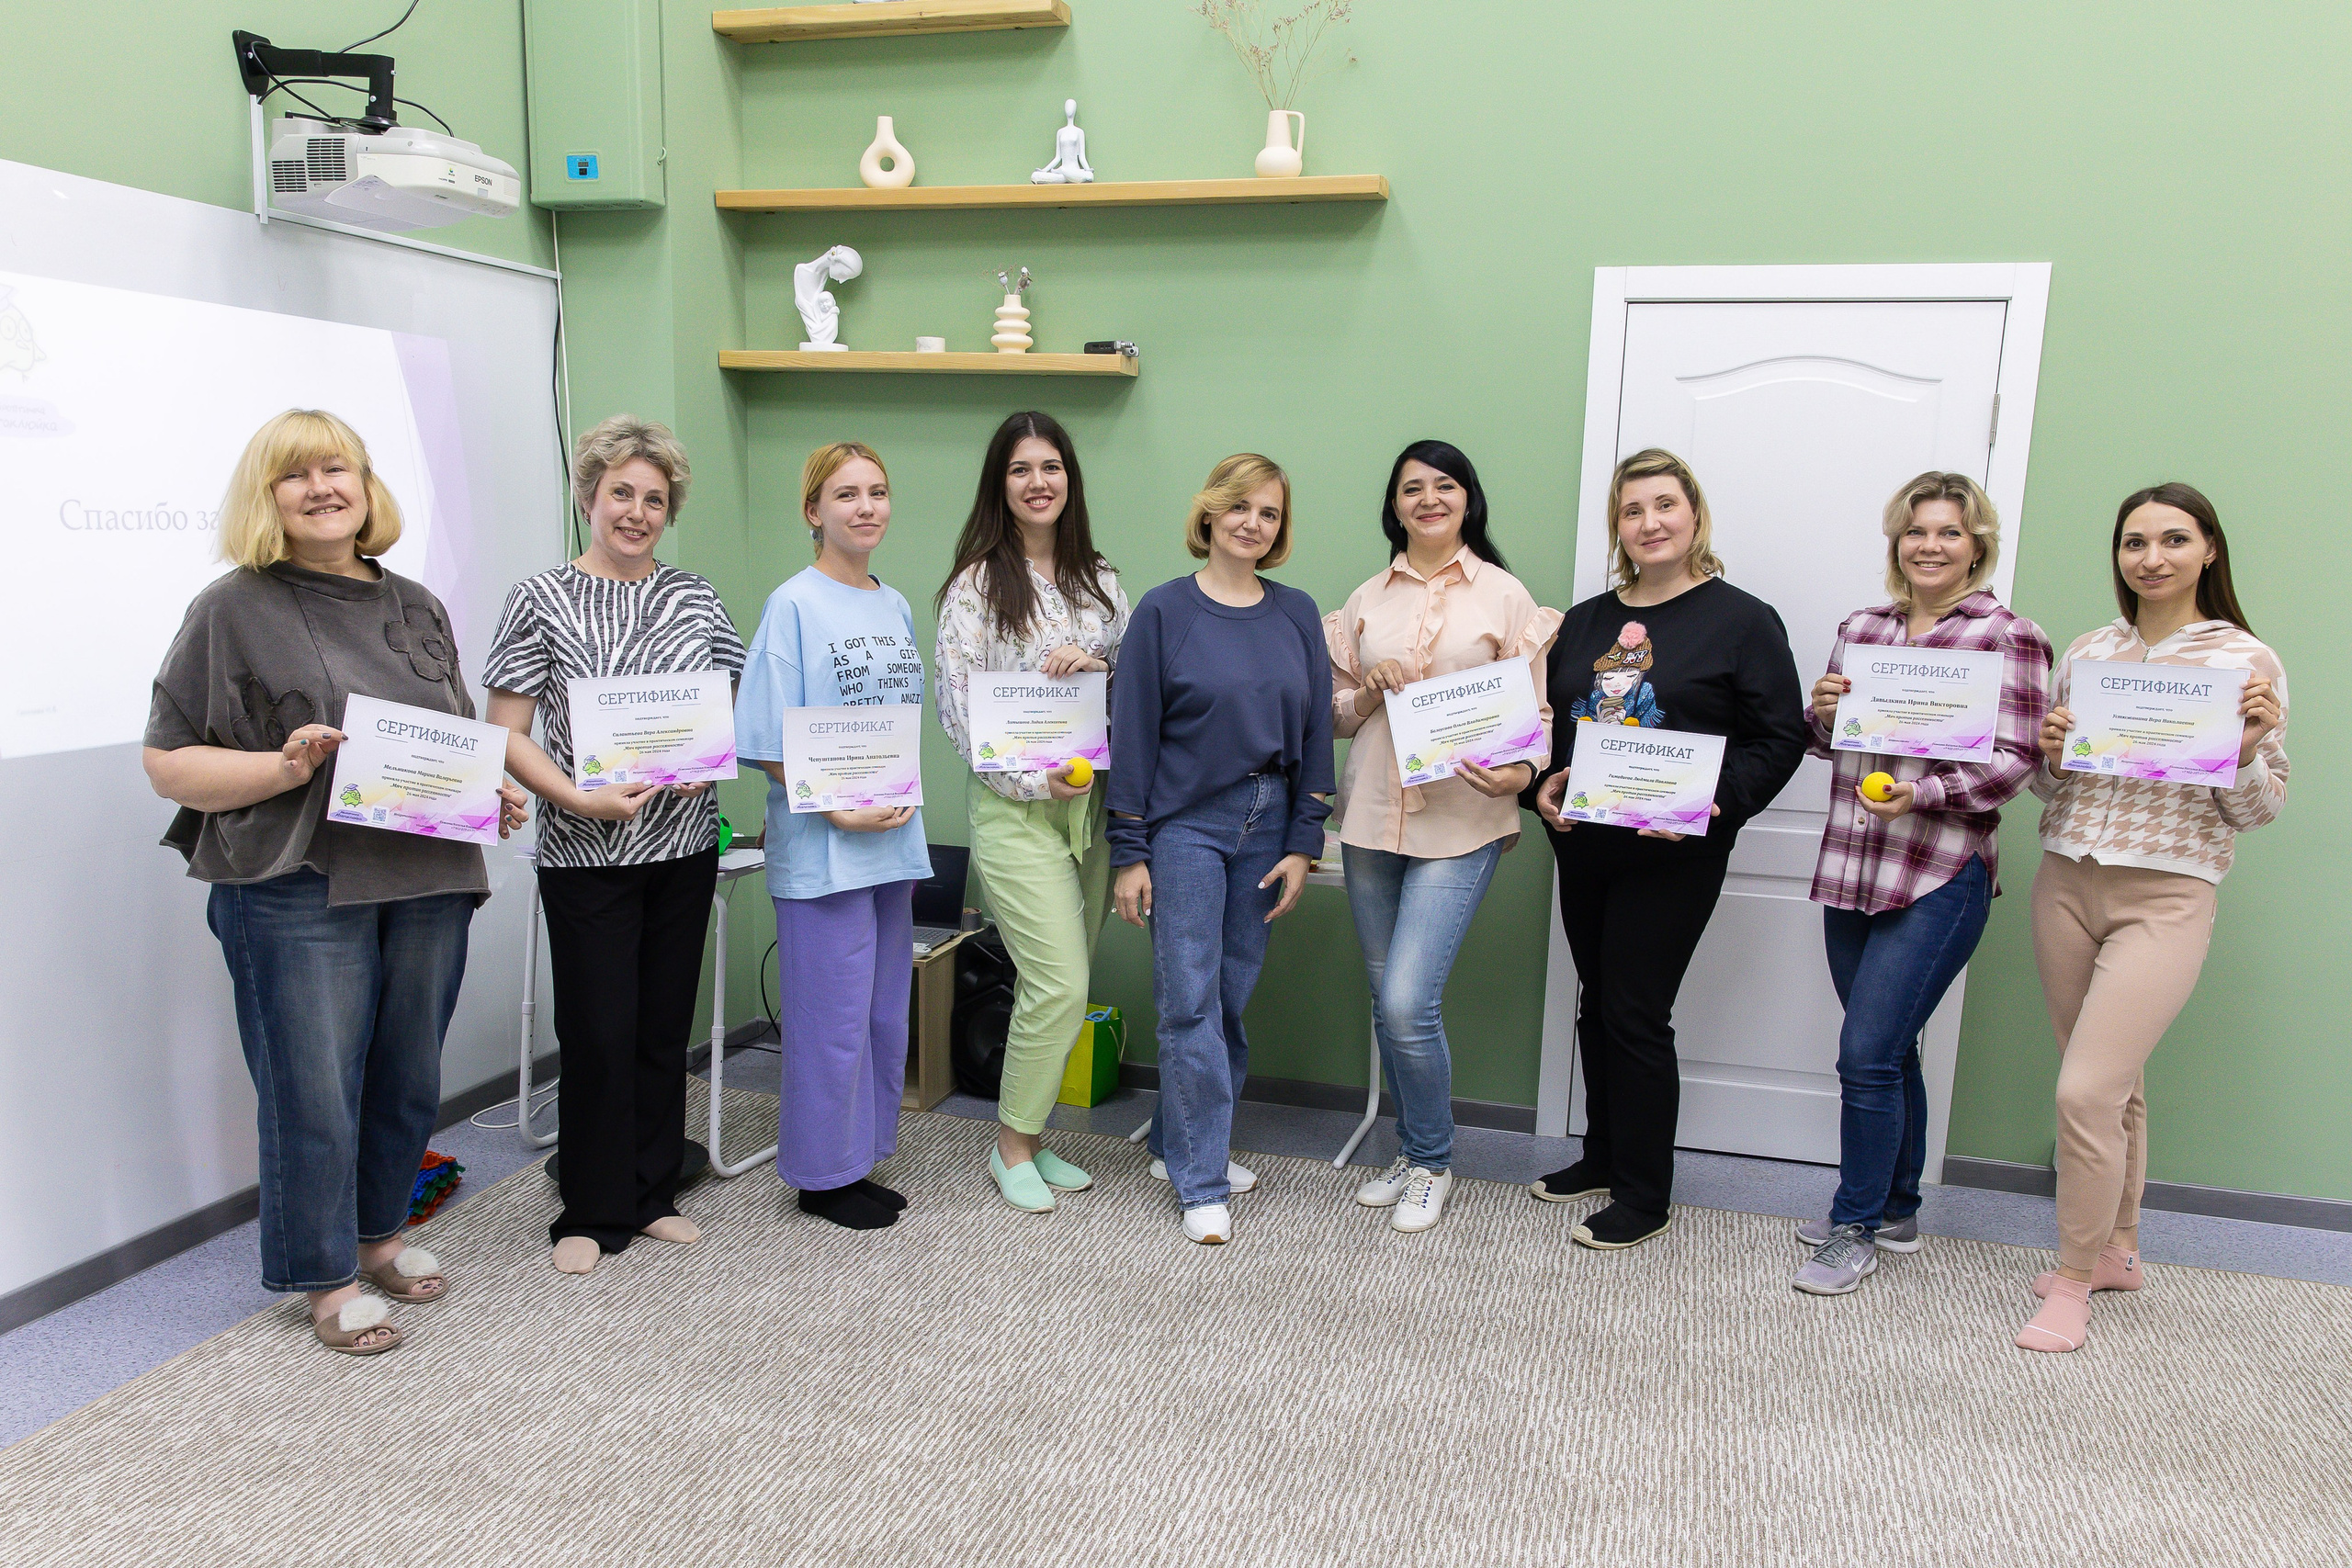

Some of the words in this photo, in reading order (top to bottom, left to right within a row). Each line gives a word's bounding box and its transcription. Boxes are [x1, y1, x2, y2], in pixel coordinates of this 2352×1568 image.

[475, 175, 492, 186] EPSON
[59, 499, 188, 531] Спасибо
[828, 643, 837, 654] I
[845, 637, 866, 649] GOT
[872, 636, 896, 646] THIS
[834, 655, 849, 668] AS
[866, 651, 874, 660] A
[900, 650, 920, 659] GIFT
[837, 665, 870, 682] FROM
[888, 663, 921, 674] SOMEONE
[1871, 662, 1970, 679] СЕРТИФИКАТ
[840, 682, 863, 696] WHO
[878, 677, 909, 689] THINKS
[993, 687, 1080, 698] СЕРТИФИКАТ
[1412, 677, 1502, 708] СЕРТИФИКАТ
[2101, 677, 2212, 696] СЕРТИФИКАТ
[598, 688, 700, 705] СЕРТИФИКАТ
[1930, 700, 1967, 709] Викторовна
[376, 719, 478, 751] СЕРТИФИКАТ
[809, 721, 894, 733] СЕРТИФИКАТ
[1601, 739, 1694, 759] СЕРТИФИКАТ
